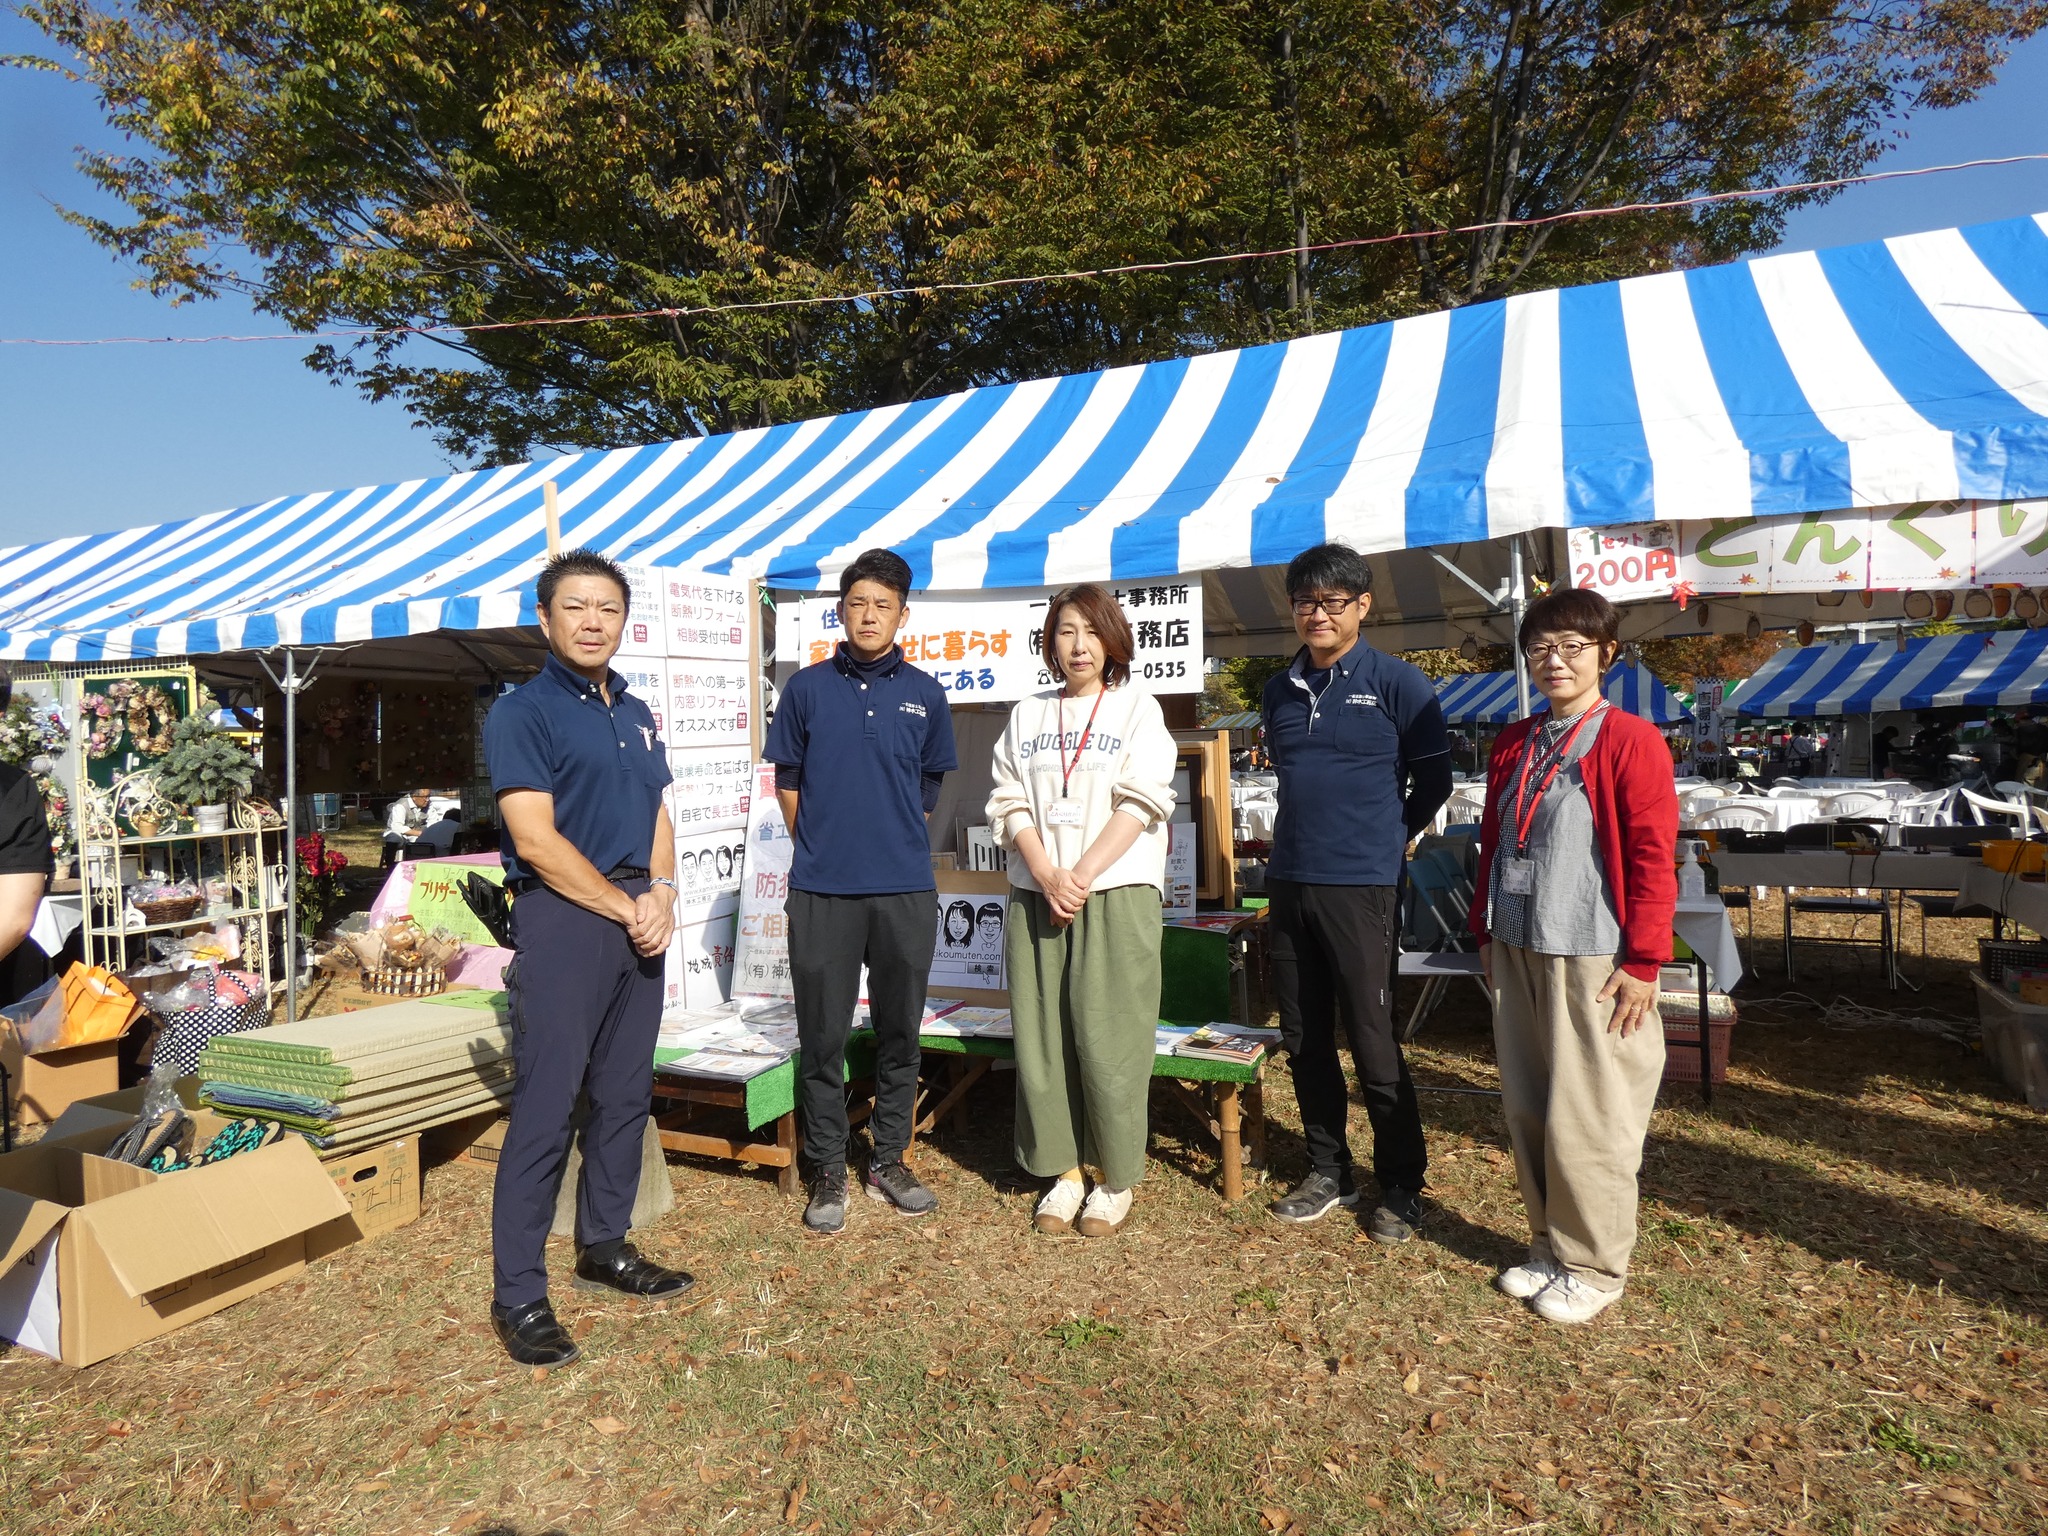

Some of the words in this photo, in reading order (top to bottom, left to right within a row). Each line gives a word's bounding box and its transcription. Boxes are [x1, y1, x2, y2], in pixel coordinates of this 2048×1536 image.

[1576, 547, 1676, 589] 200円
[669, 582, 744, 605] 電気代を下げる
[671, 603, 745, 624] 断熱リフォーム
[677, 628, 730, 645] 相談受付中
[1130, 618, 1189, 649] 務店
[673, 674, 746, 689] 断熱への第一歩
[674, 695, 746, 709] 内窓リフォーム
[675, 718, 736, 732] オススメです
[1020, 731, 1095, 759] SNUGGLE
[1098, 733, 1122, 755] UP
[681, 803, 740, 823] 自宅で長生き
